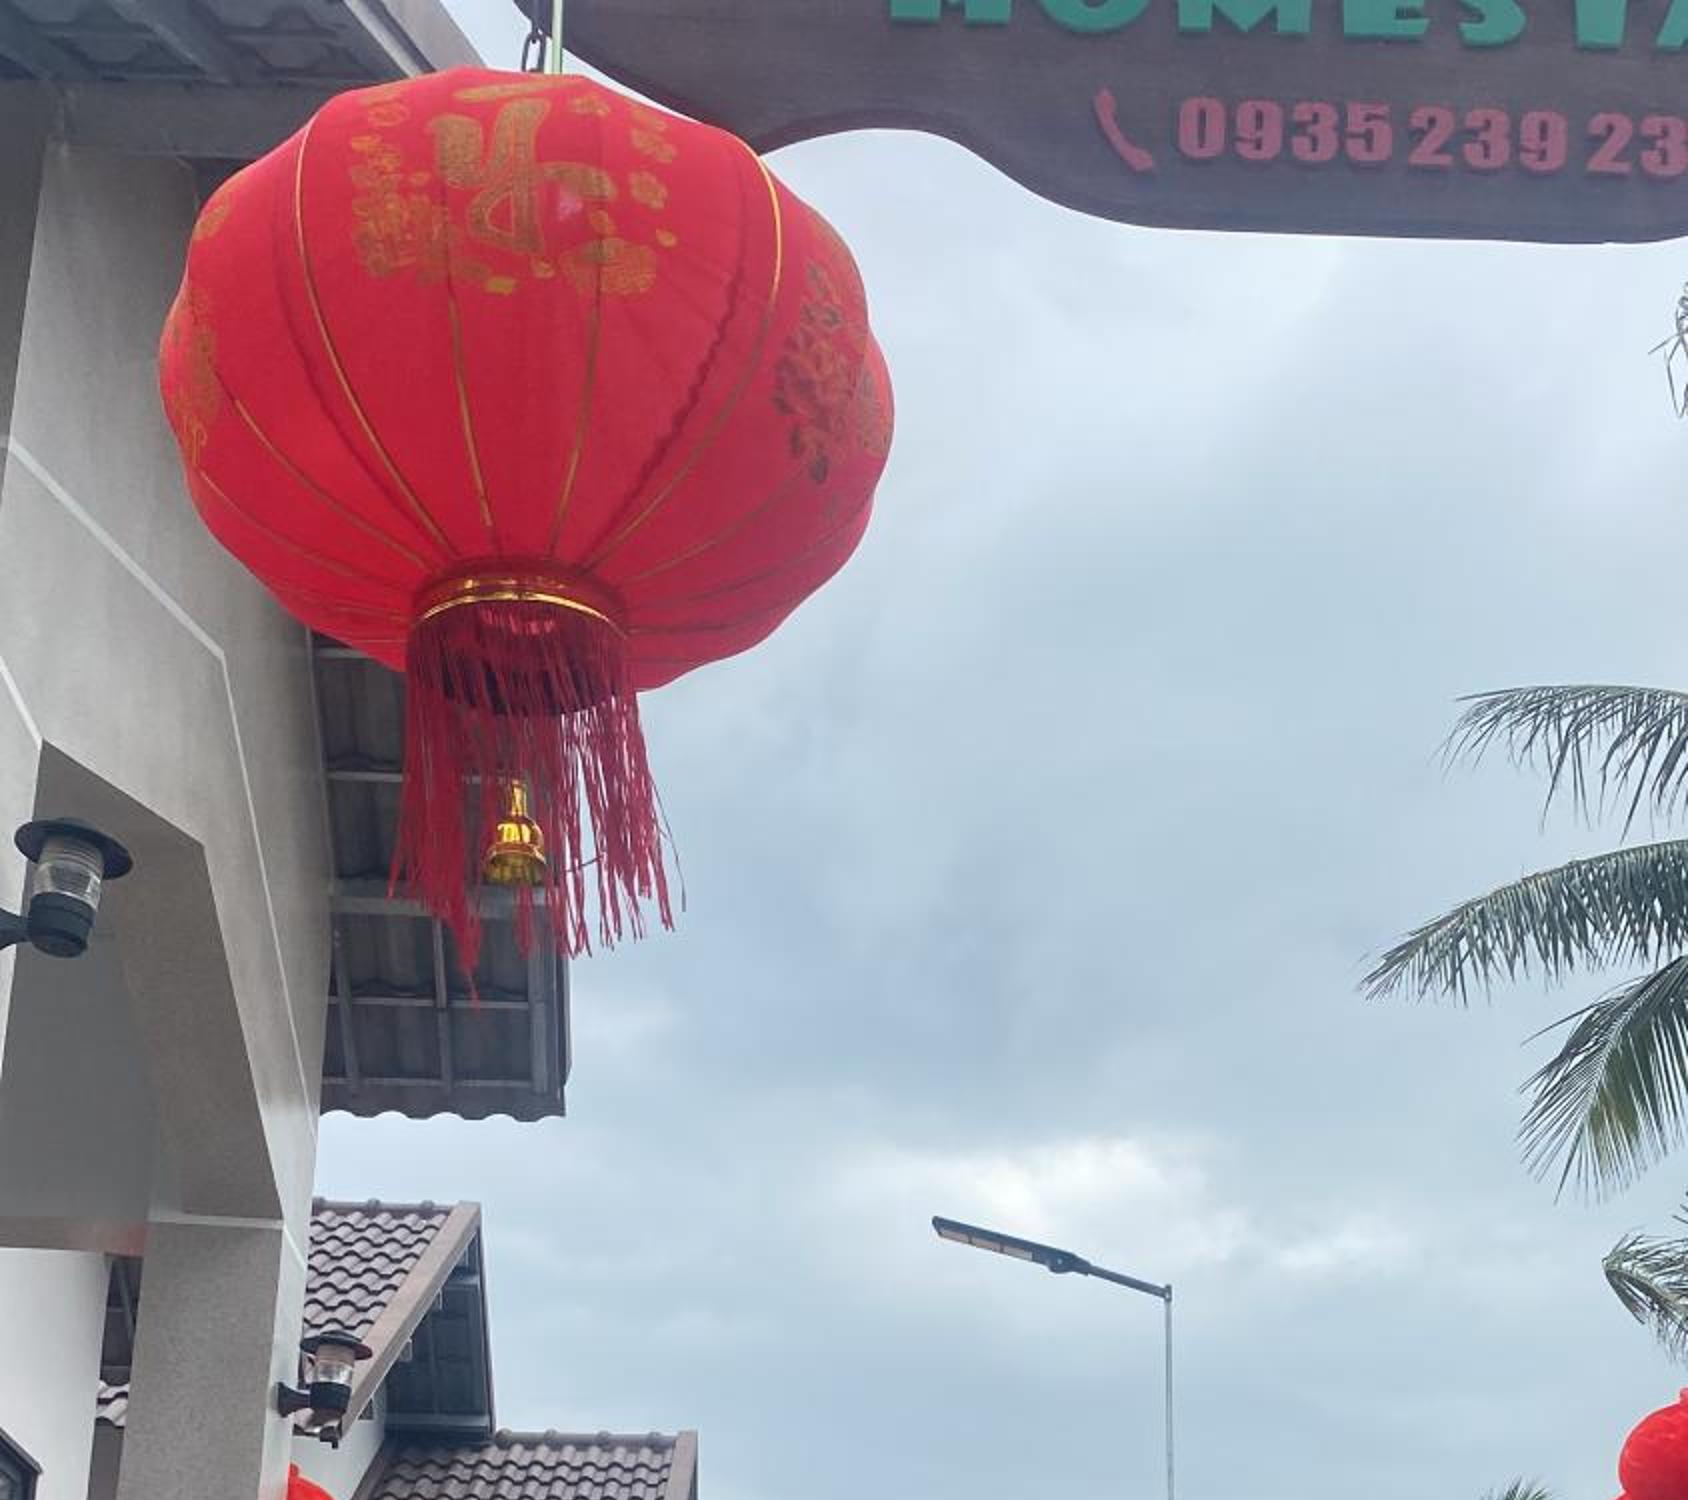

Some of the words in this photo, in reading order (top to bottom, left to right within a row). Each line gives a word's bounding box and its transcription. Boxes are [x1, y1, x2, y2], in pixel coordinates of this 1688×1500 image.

[1177, 98, 1393, 163] 0935
[1407, 105, 1568, 172] 239
[1586, 111, 1688, 177] 23
